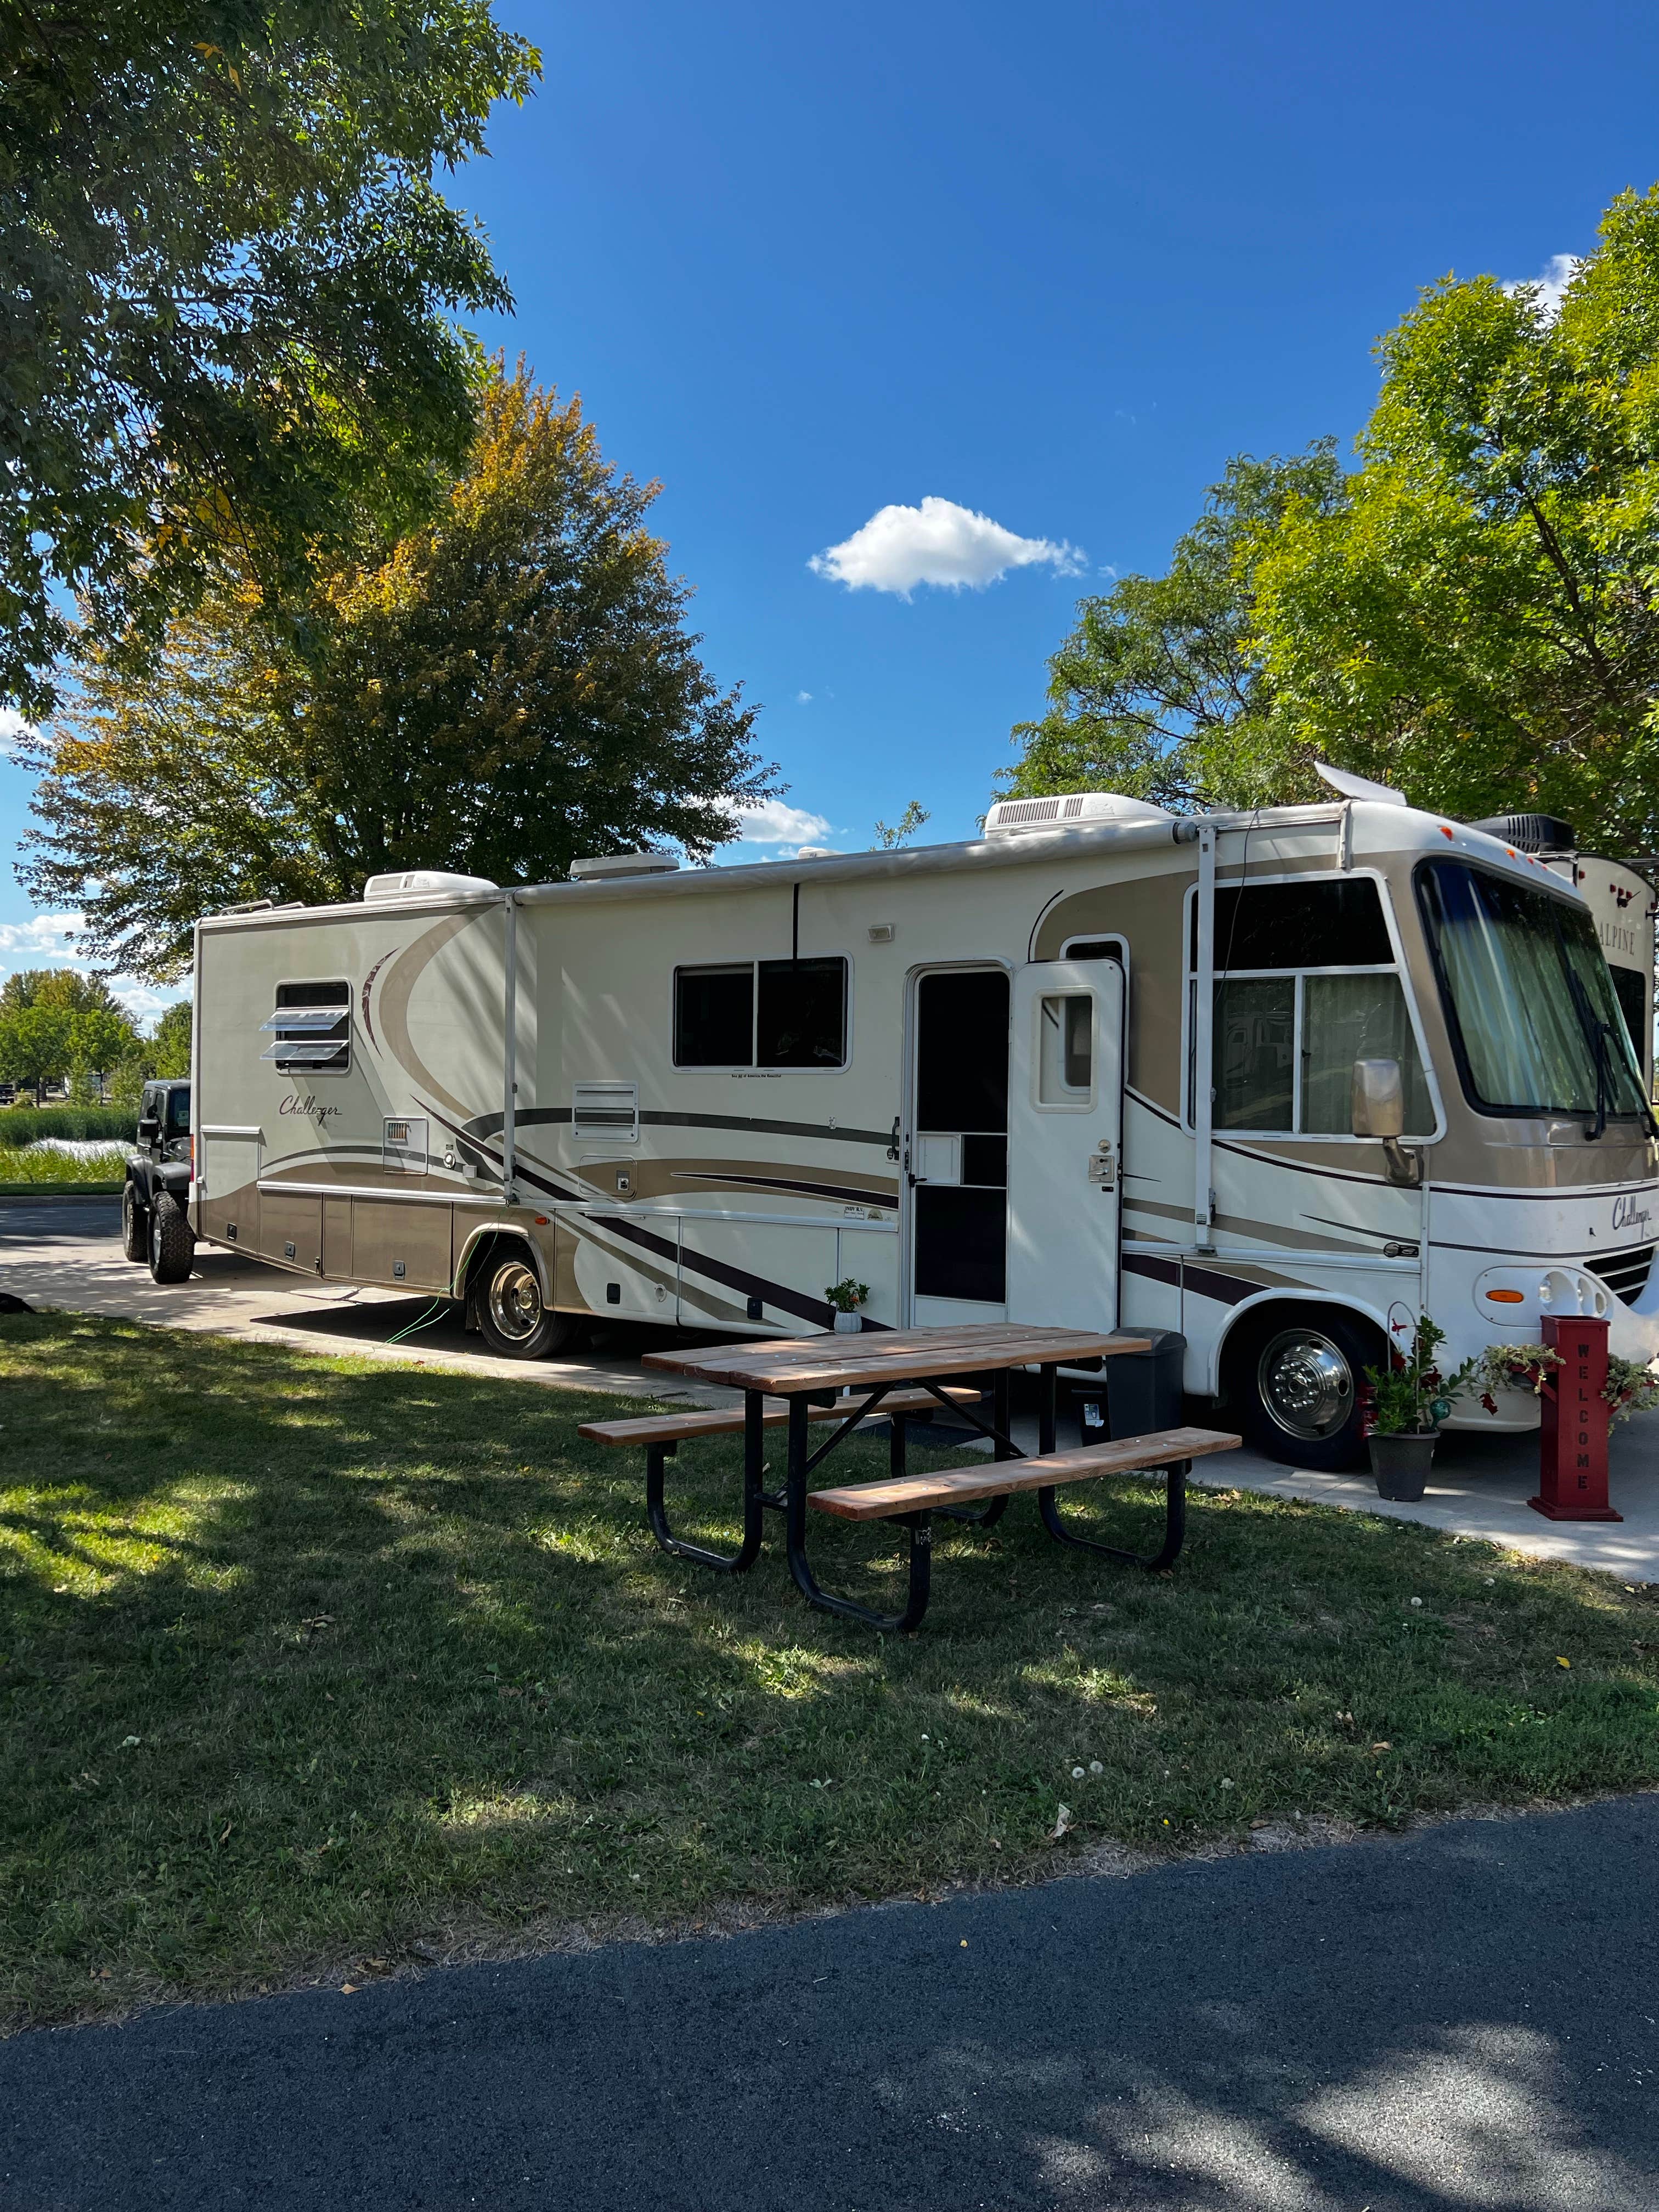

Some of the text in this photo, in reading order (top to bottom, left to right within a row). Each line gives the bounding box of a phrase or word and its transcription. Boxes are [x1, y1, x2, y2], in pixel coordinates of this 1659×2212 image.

[1600, 921, 1635, 956] ALPINE
[279, 1095, 343, 1126] Challenger
[1577, 1344, 1589, 1489] WELCOME
